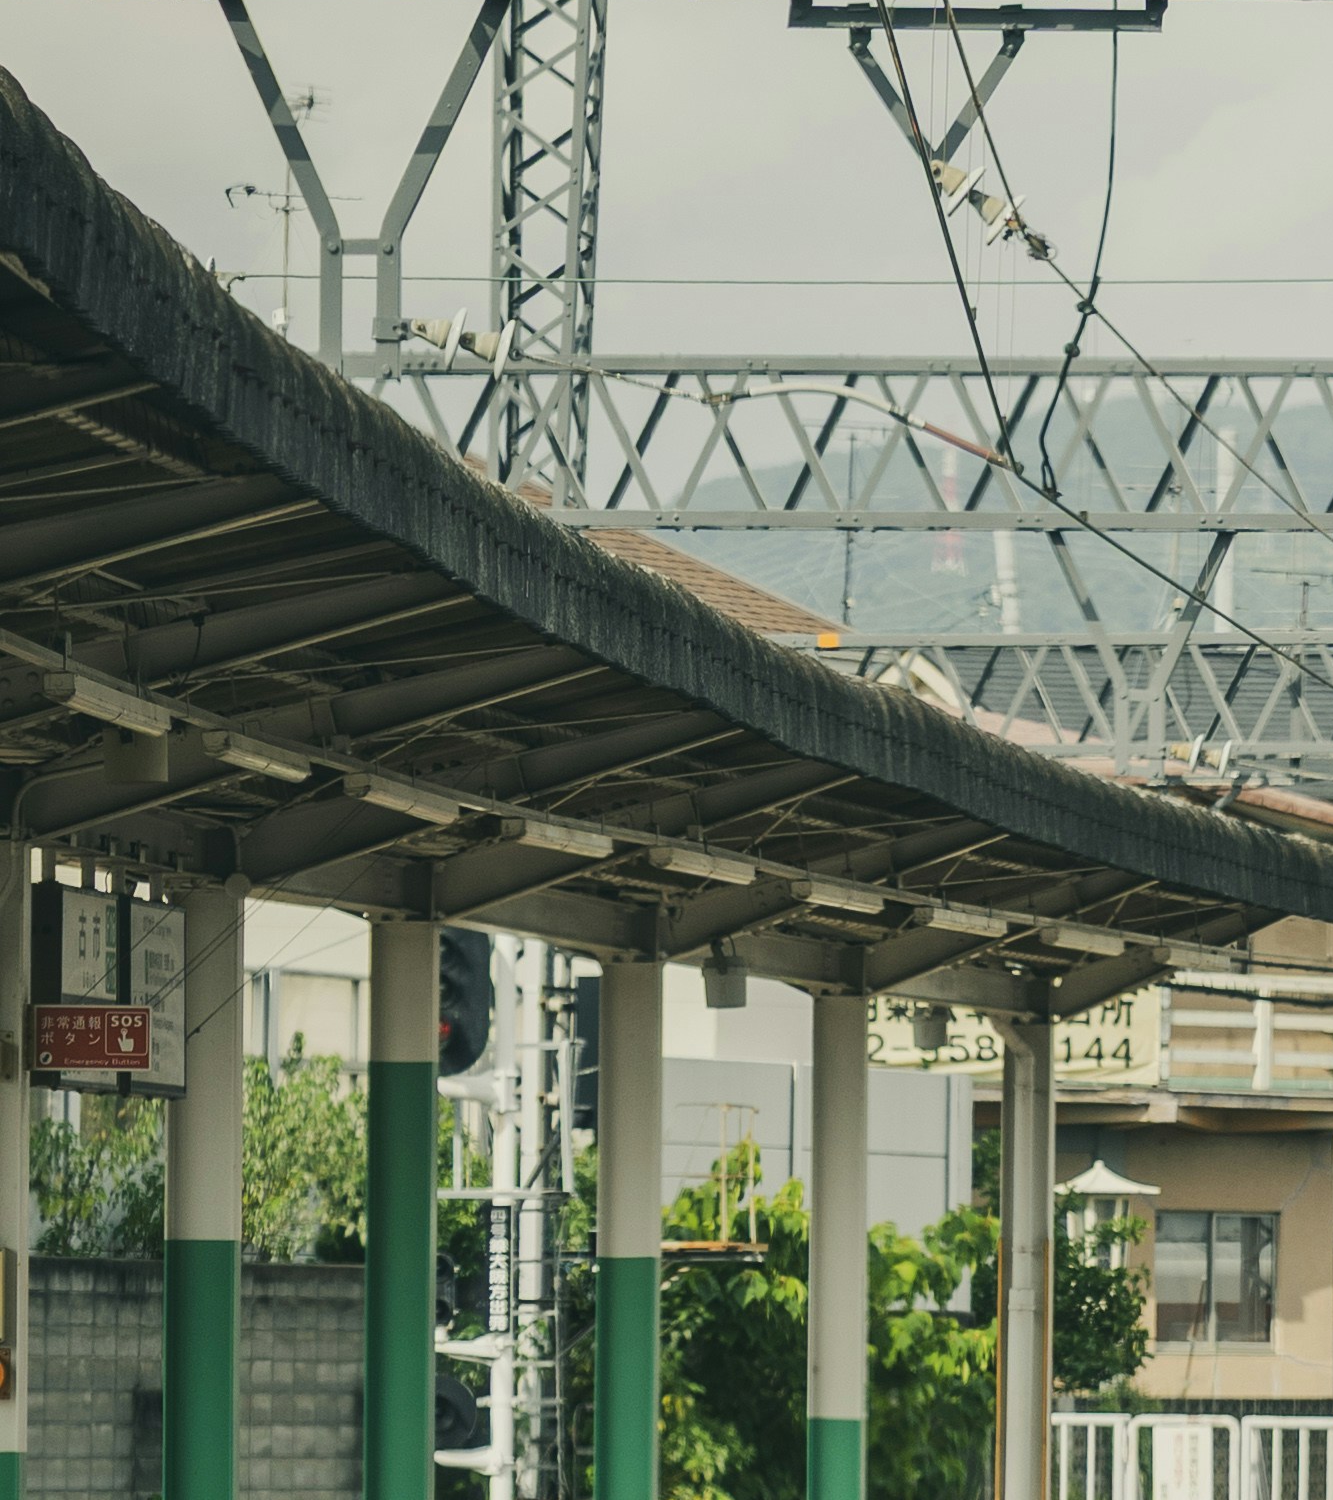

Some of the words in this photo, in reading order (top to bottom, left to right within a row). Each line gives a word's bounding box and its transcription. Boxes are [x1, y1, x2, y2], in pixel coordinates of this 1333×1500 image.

[40, 1015, 101, 1030] 非常通報
[111, 1015, 143, 1027] SOS
[40, 1031, 101, 1045] ボタン
[64, 1057, 109, 1066] Emergency
[112, 1057, 141, 1065] Button
